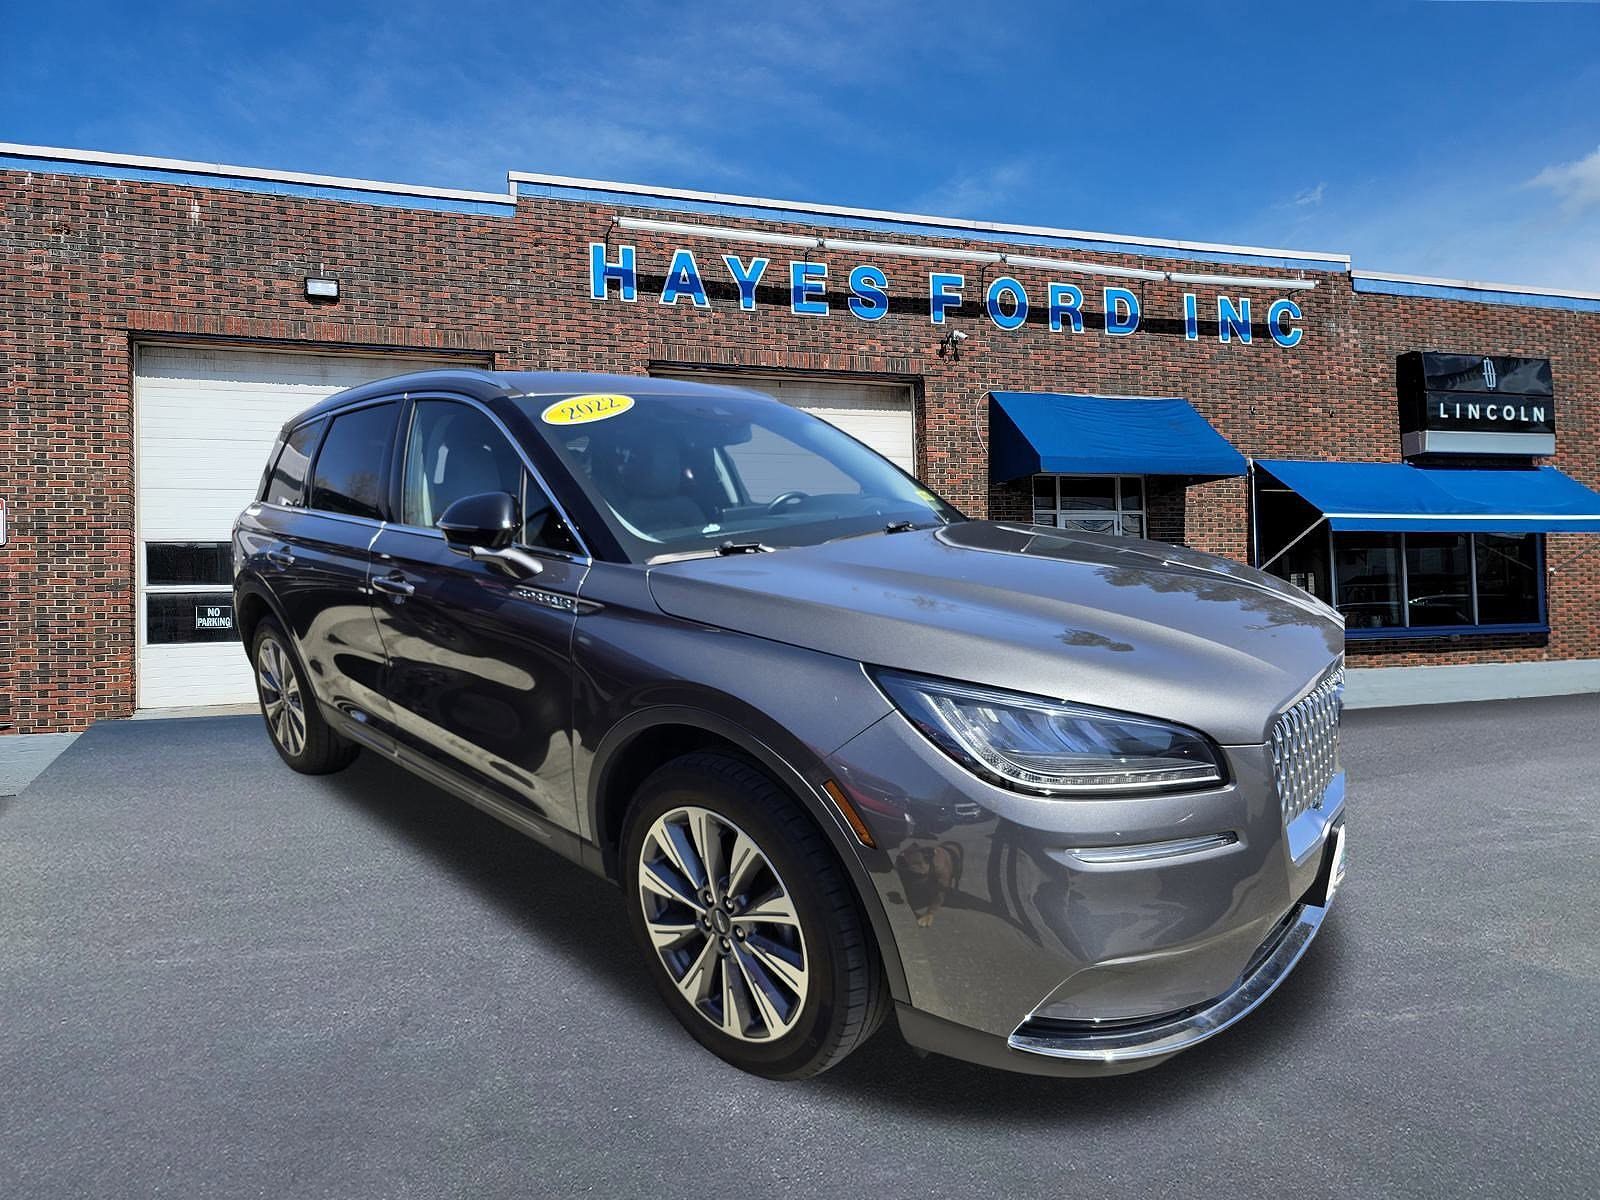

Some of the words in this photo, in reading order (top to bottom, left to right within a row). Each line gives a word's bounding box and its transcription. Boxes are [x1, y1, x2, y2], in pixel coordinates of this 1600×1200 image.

[589, 242, 889, 321] HAYES
[929, 272, 1141, 336] FORD
[1184, 293, 1304, 348] INC
[561, 397, 621, 420] 2022
[1439, 402, 1545, 423] LINCOLN
[197, 617, 231, 627] PARKING
[207, 607, 221, 617] NO
